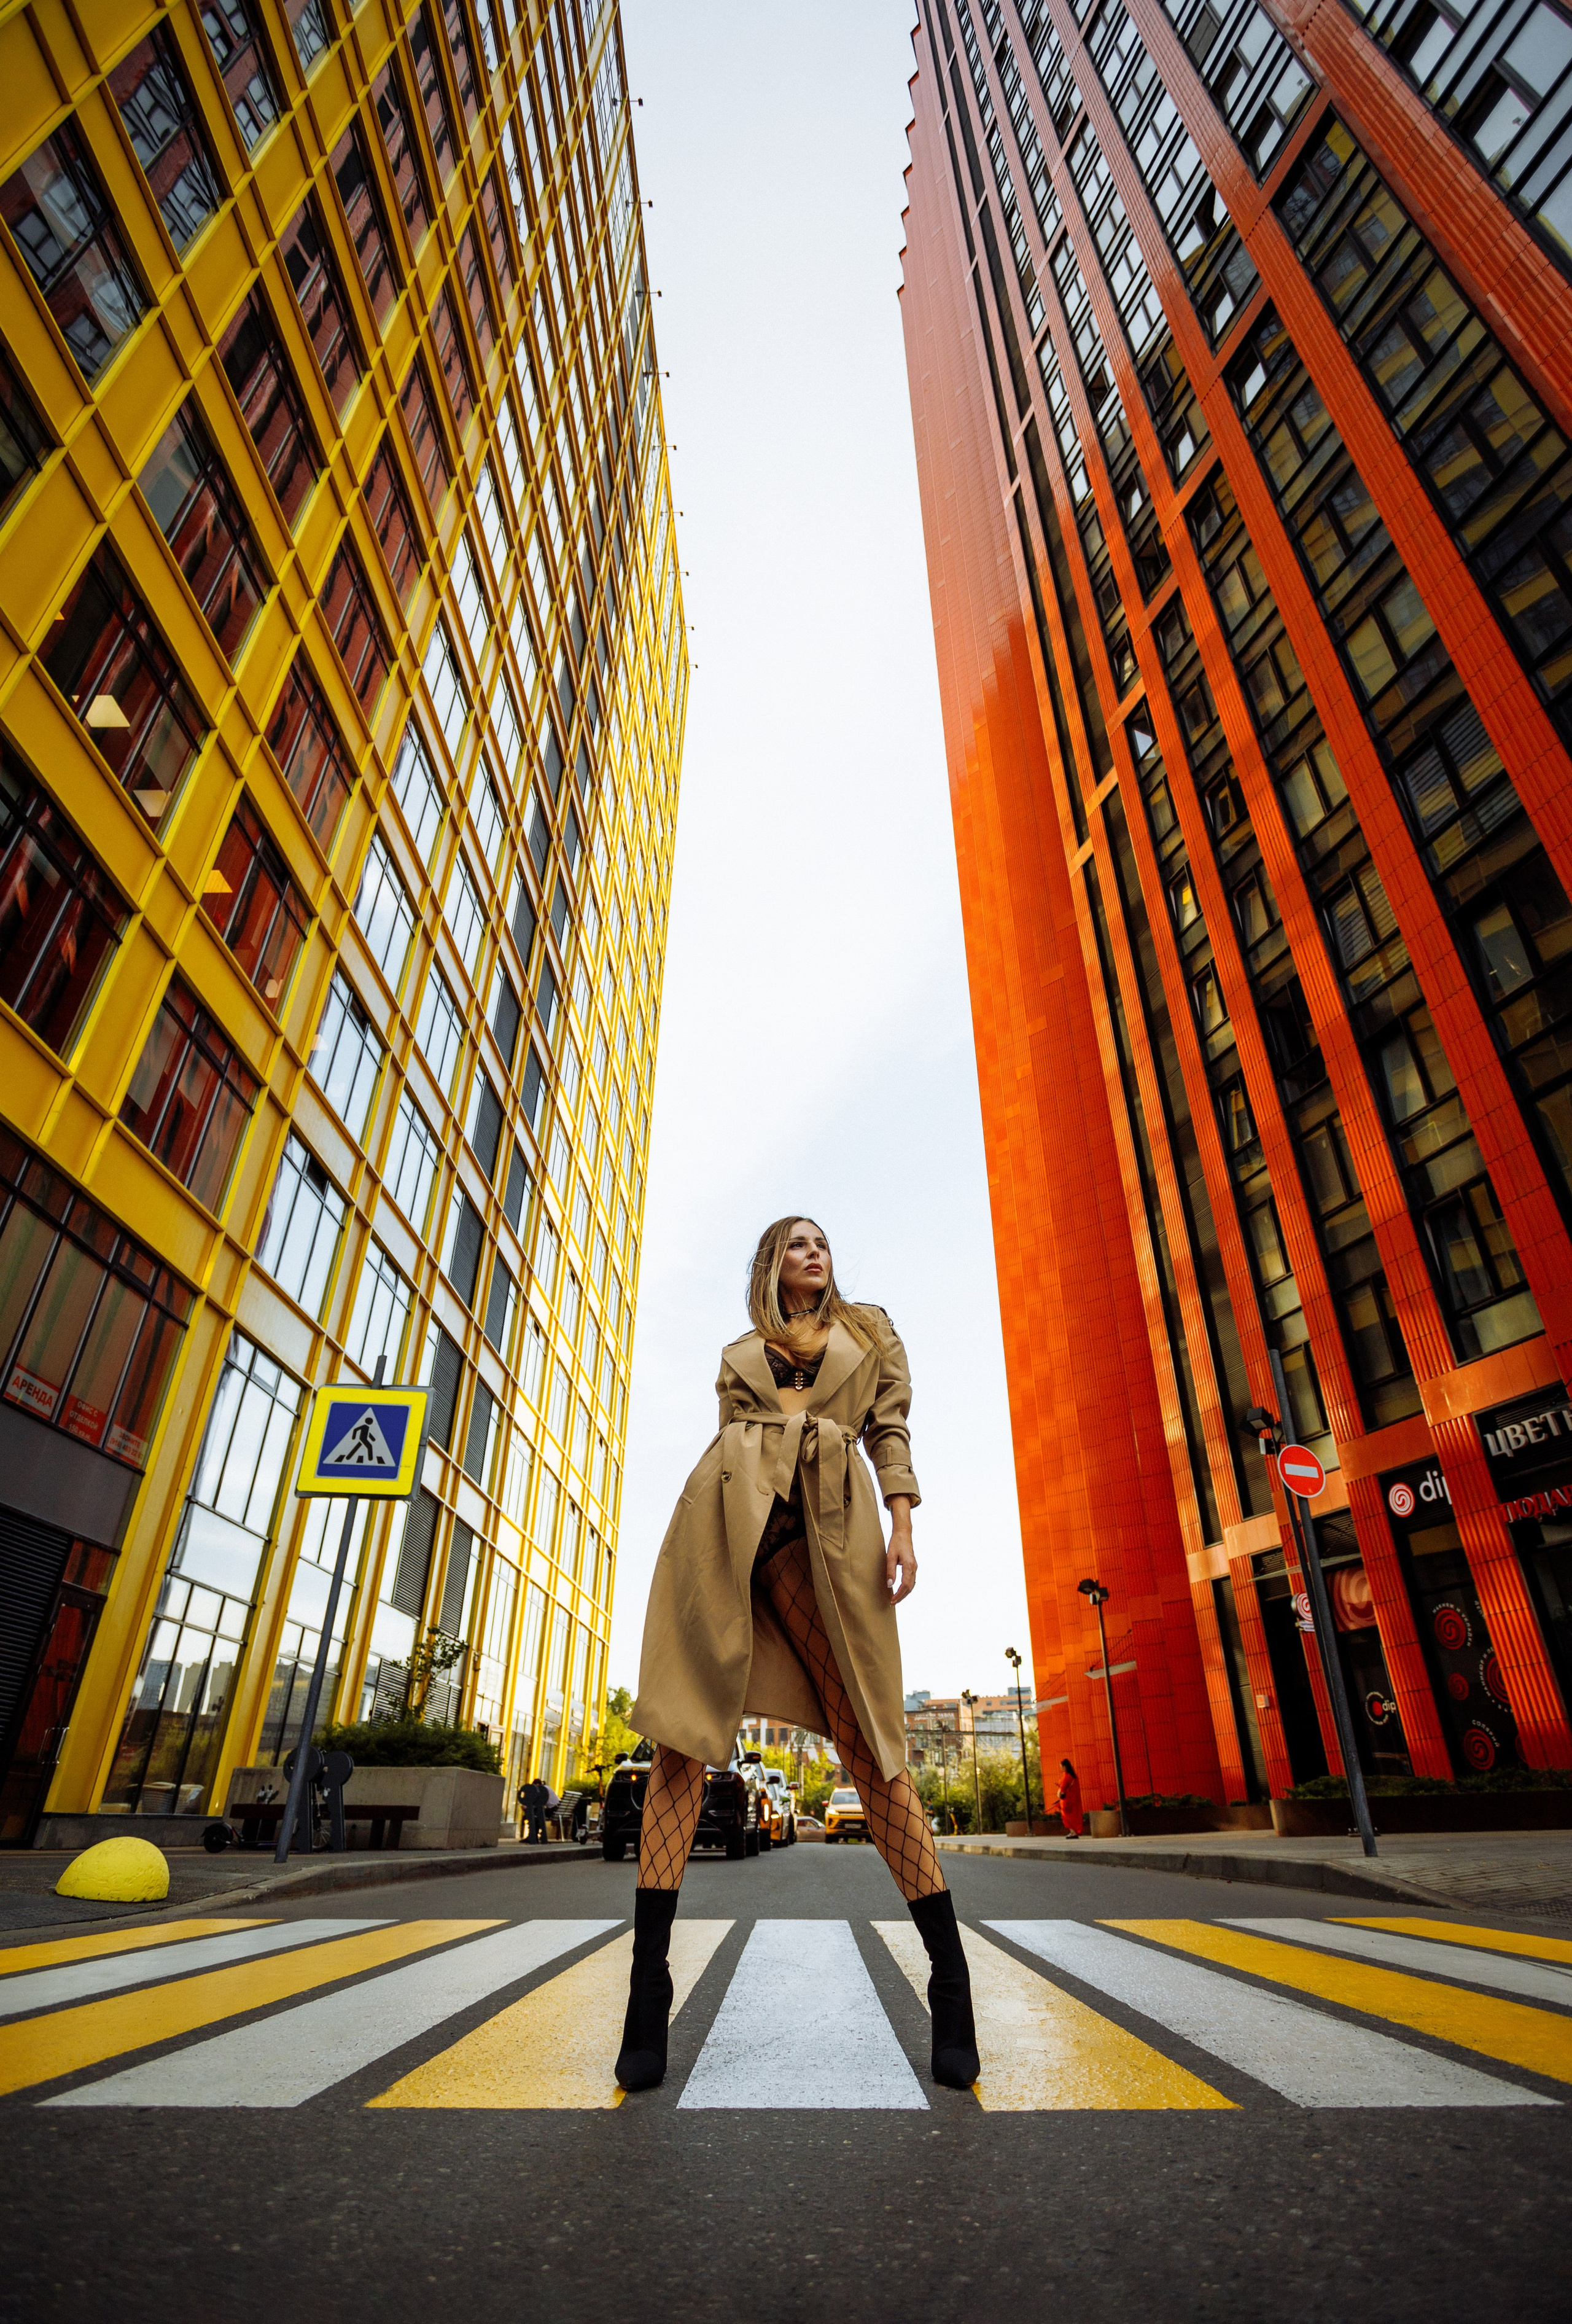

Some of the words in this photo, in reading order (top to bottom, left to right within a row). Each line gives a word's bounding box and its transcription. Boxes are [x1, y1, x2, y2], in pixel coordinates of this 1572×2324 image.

[12, 1376, 53, 1408] АРЕНДА
[77, 1401, 93, 1415] ОФИС
[69, 1410, 98, 1430] ОТДЕЛКОЙ
